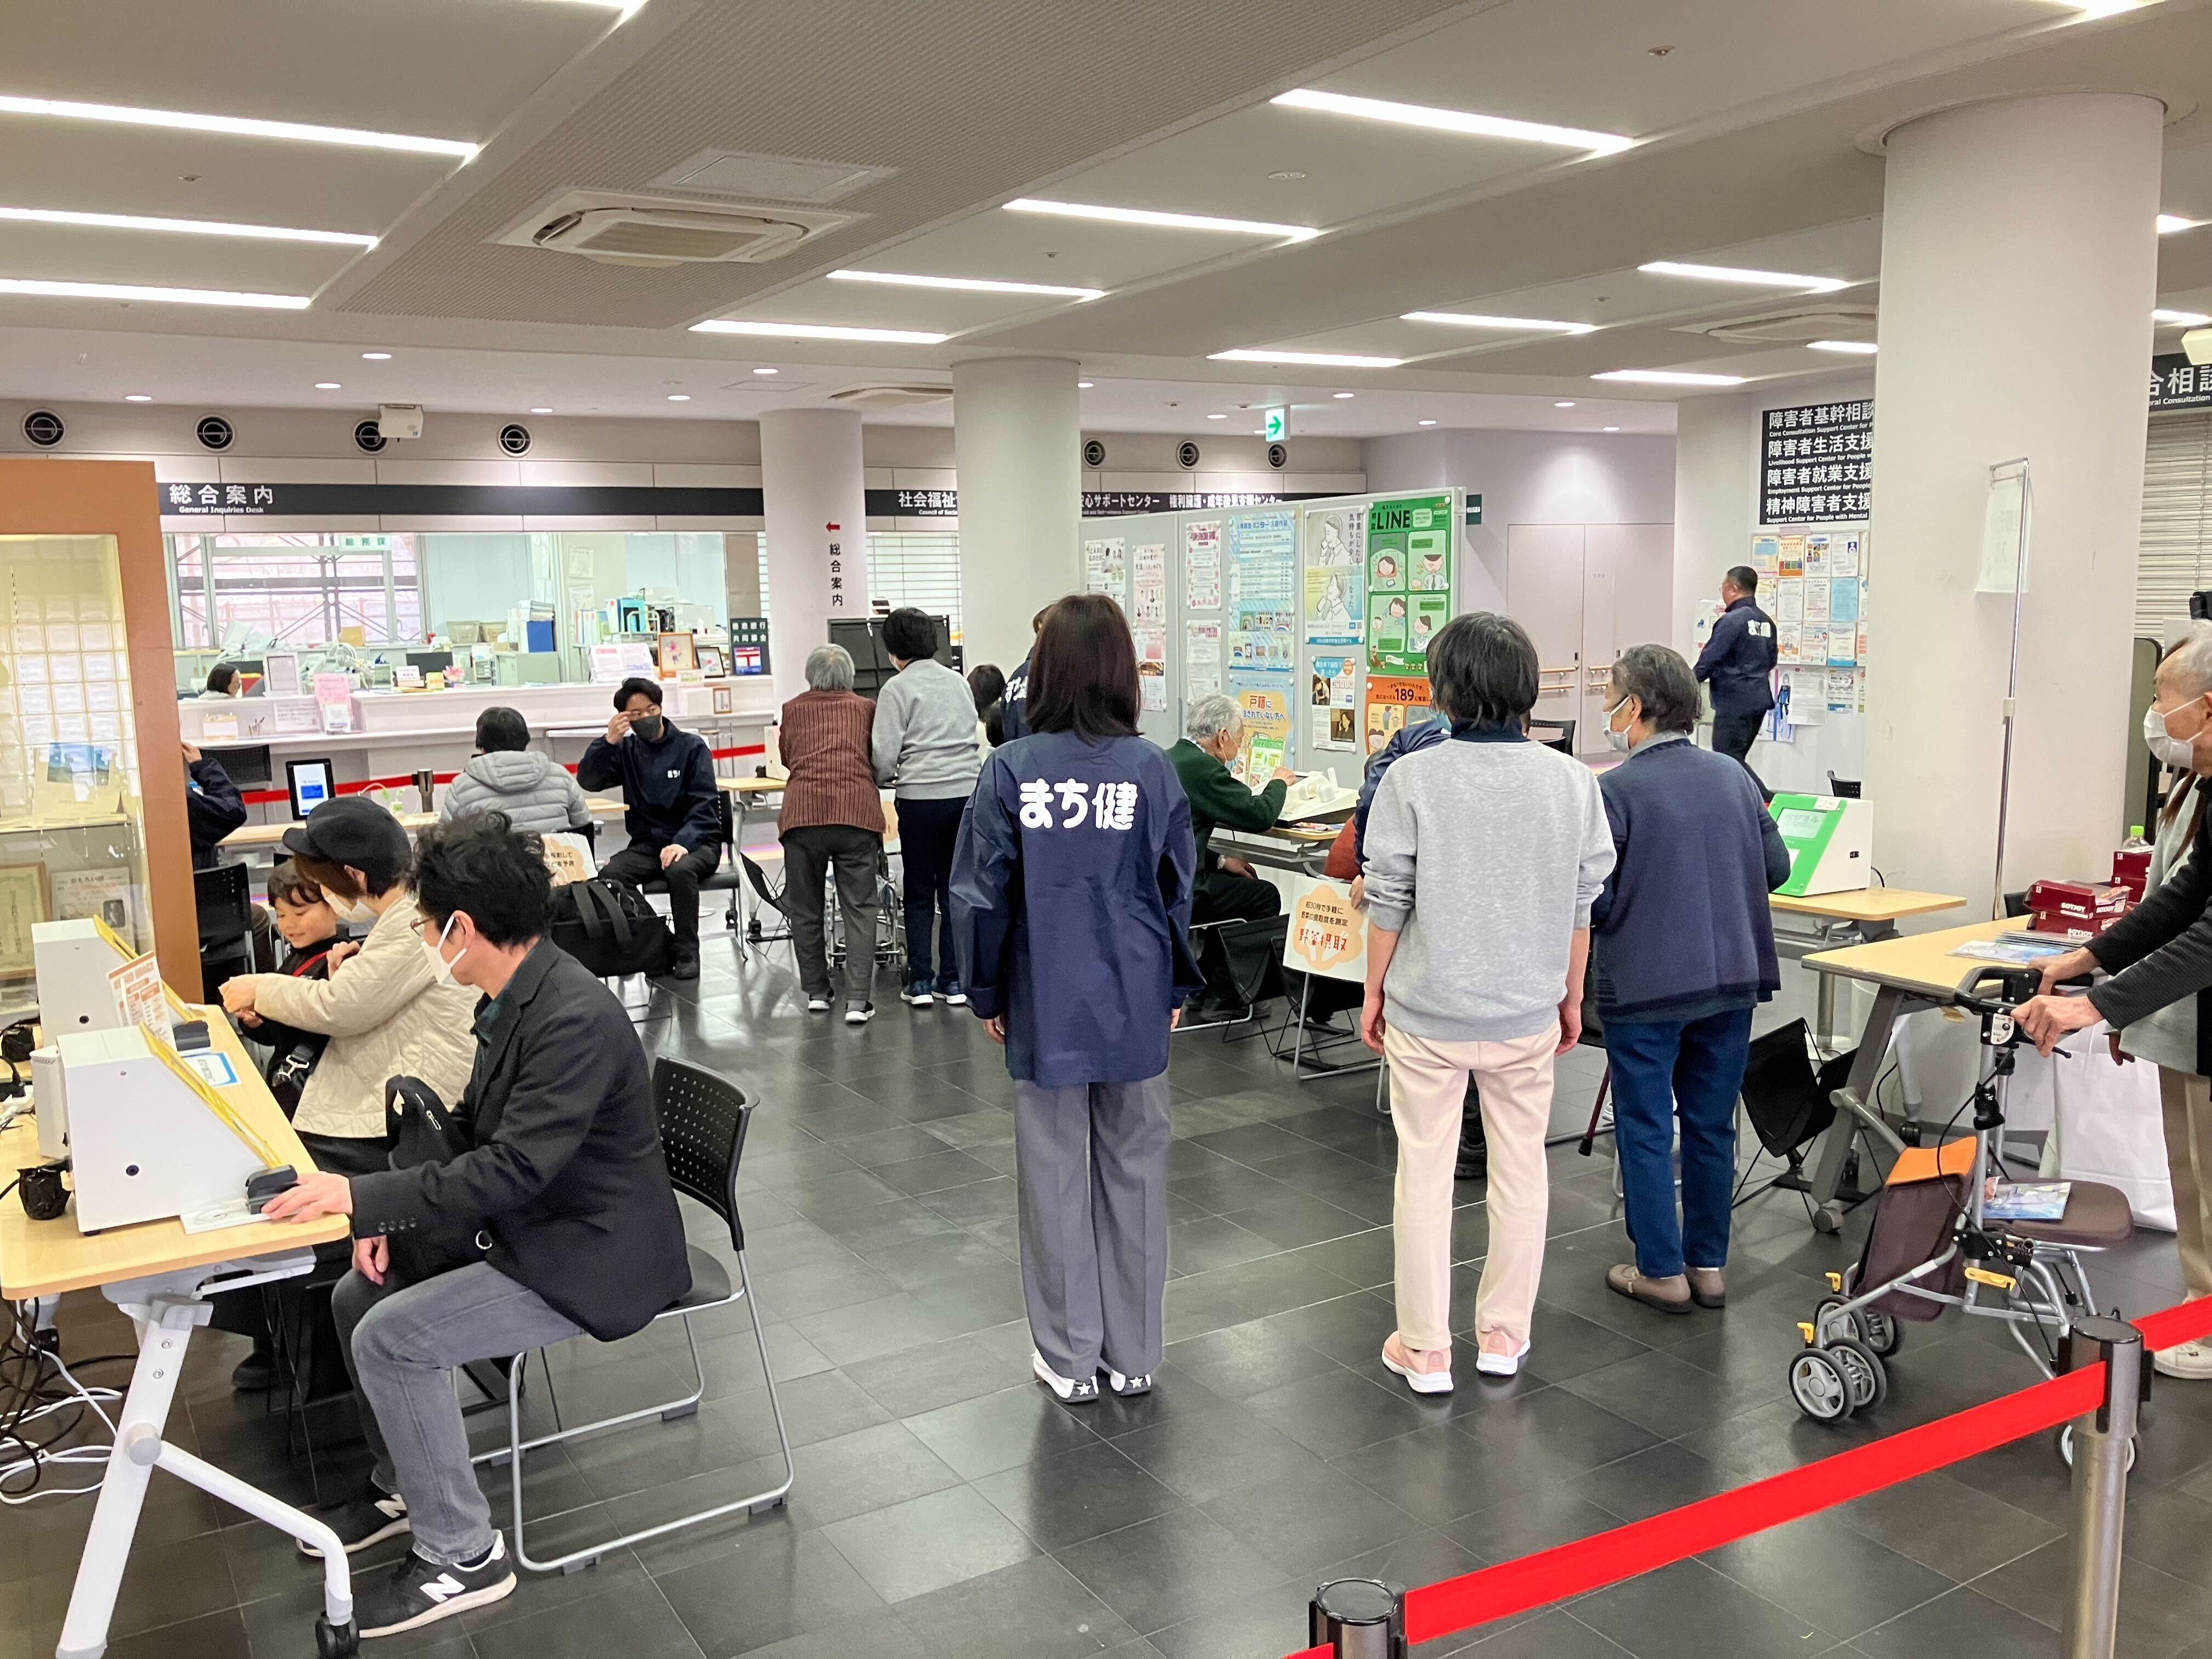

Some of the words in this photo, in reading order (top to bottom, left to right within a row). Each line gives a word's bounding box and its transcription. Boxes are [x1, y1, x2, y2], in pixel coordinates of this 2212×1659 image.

[2163, 395, 2210, 404] Consultation
[1783, 427, 1815, 436] Consultation
[1839, 422, 1858, 431] Center
[1768, 432, 1873, 458] 障害者生活支援
[1767, 462, 1872, 487] 障害者就業支援
[170, 484, 273, 505] 総合案内
[899, 491, 957, 508] 社会福祉
[1766, 492, 1870, 515] 精神障害者支援
[210, 506, 244, 515] Inquiries
[1377, 510, 1410, 530] LINE
[830, 543, 843, 606] 総合案内
[1395, 688, 1414, 701] 189
[1019, 777, 1138, 831] まち健
[420, 1572, 466, 1603] N
